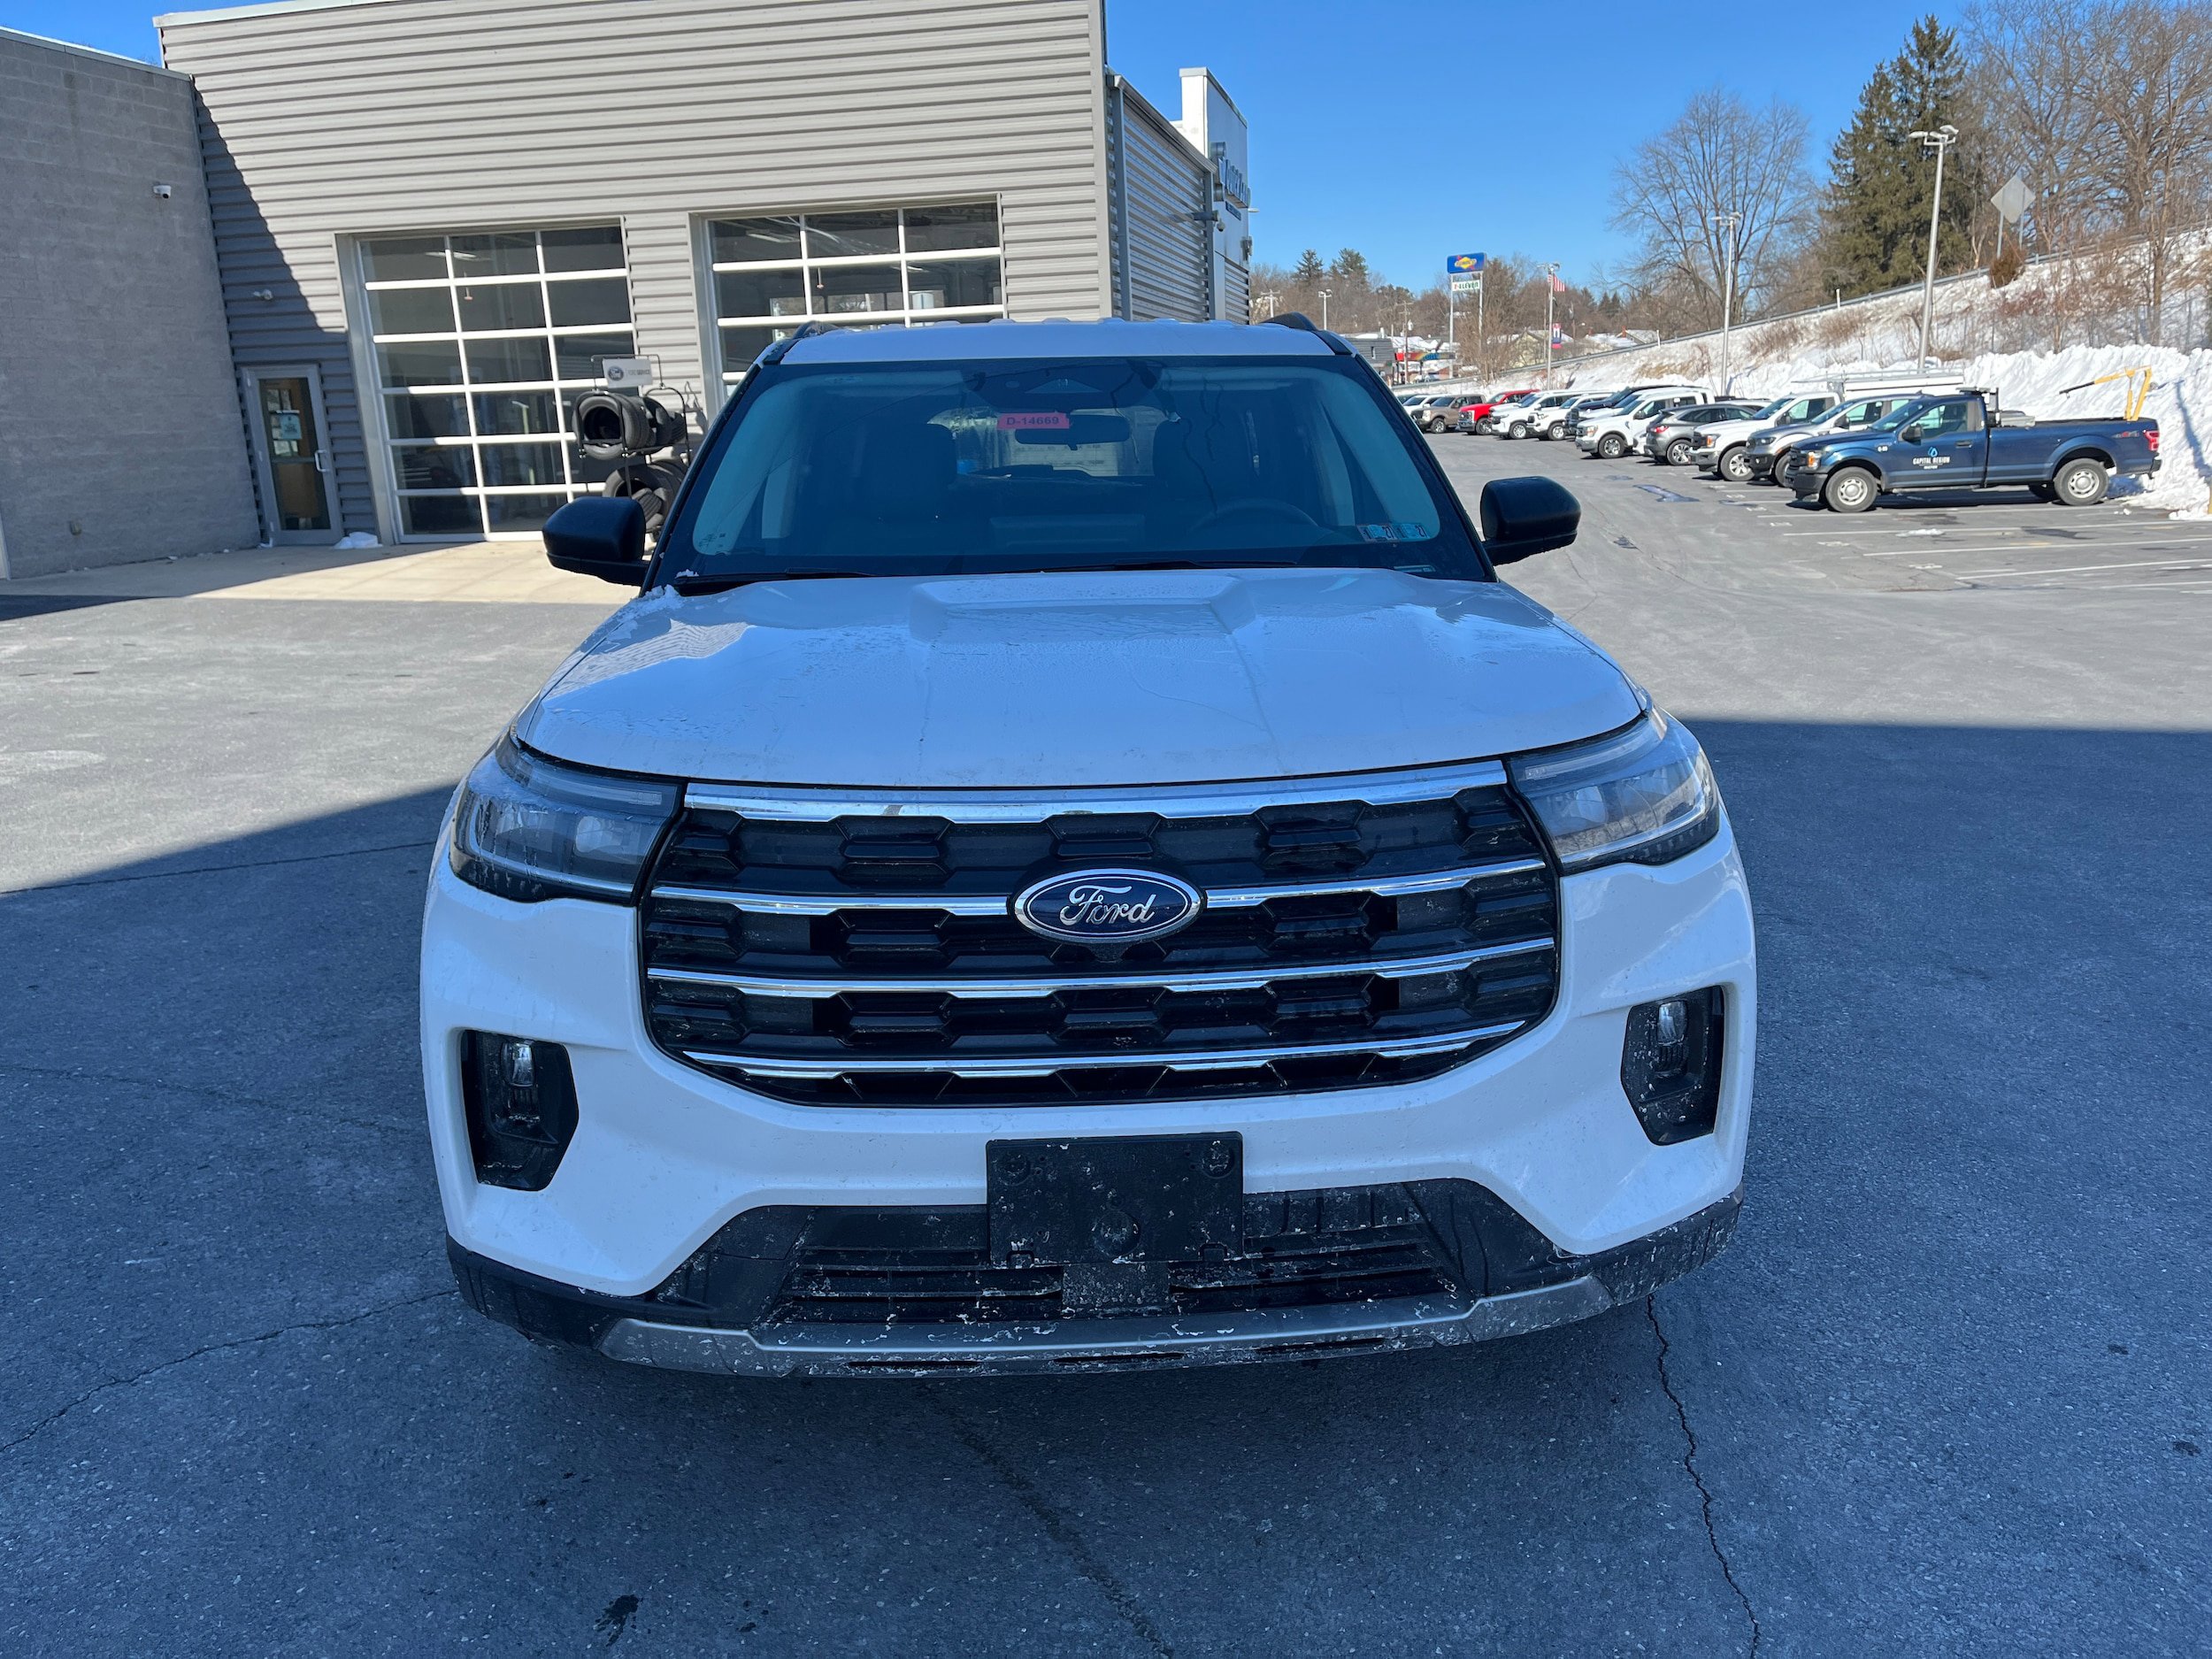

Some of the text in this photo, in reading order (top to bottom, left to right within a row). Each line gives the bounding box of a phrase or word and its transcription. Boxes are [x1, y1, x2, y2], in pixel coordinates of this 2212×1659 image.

[1005, 416, 1060, 426] D-14669
[1912, 457, 1932, 465] CAPITAL
[1059, 885, 1157, 926] Ford
